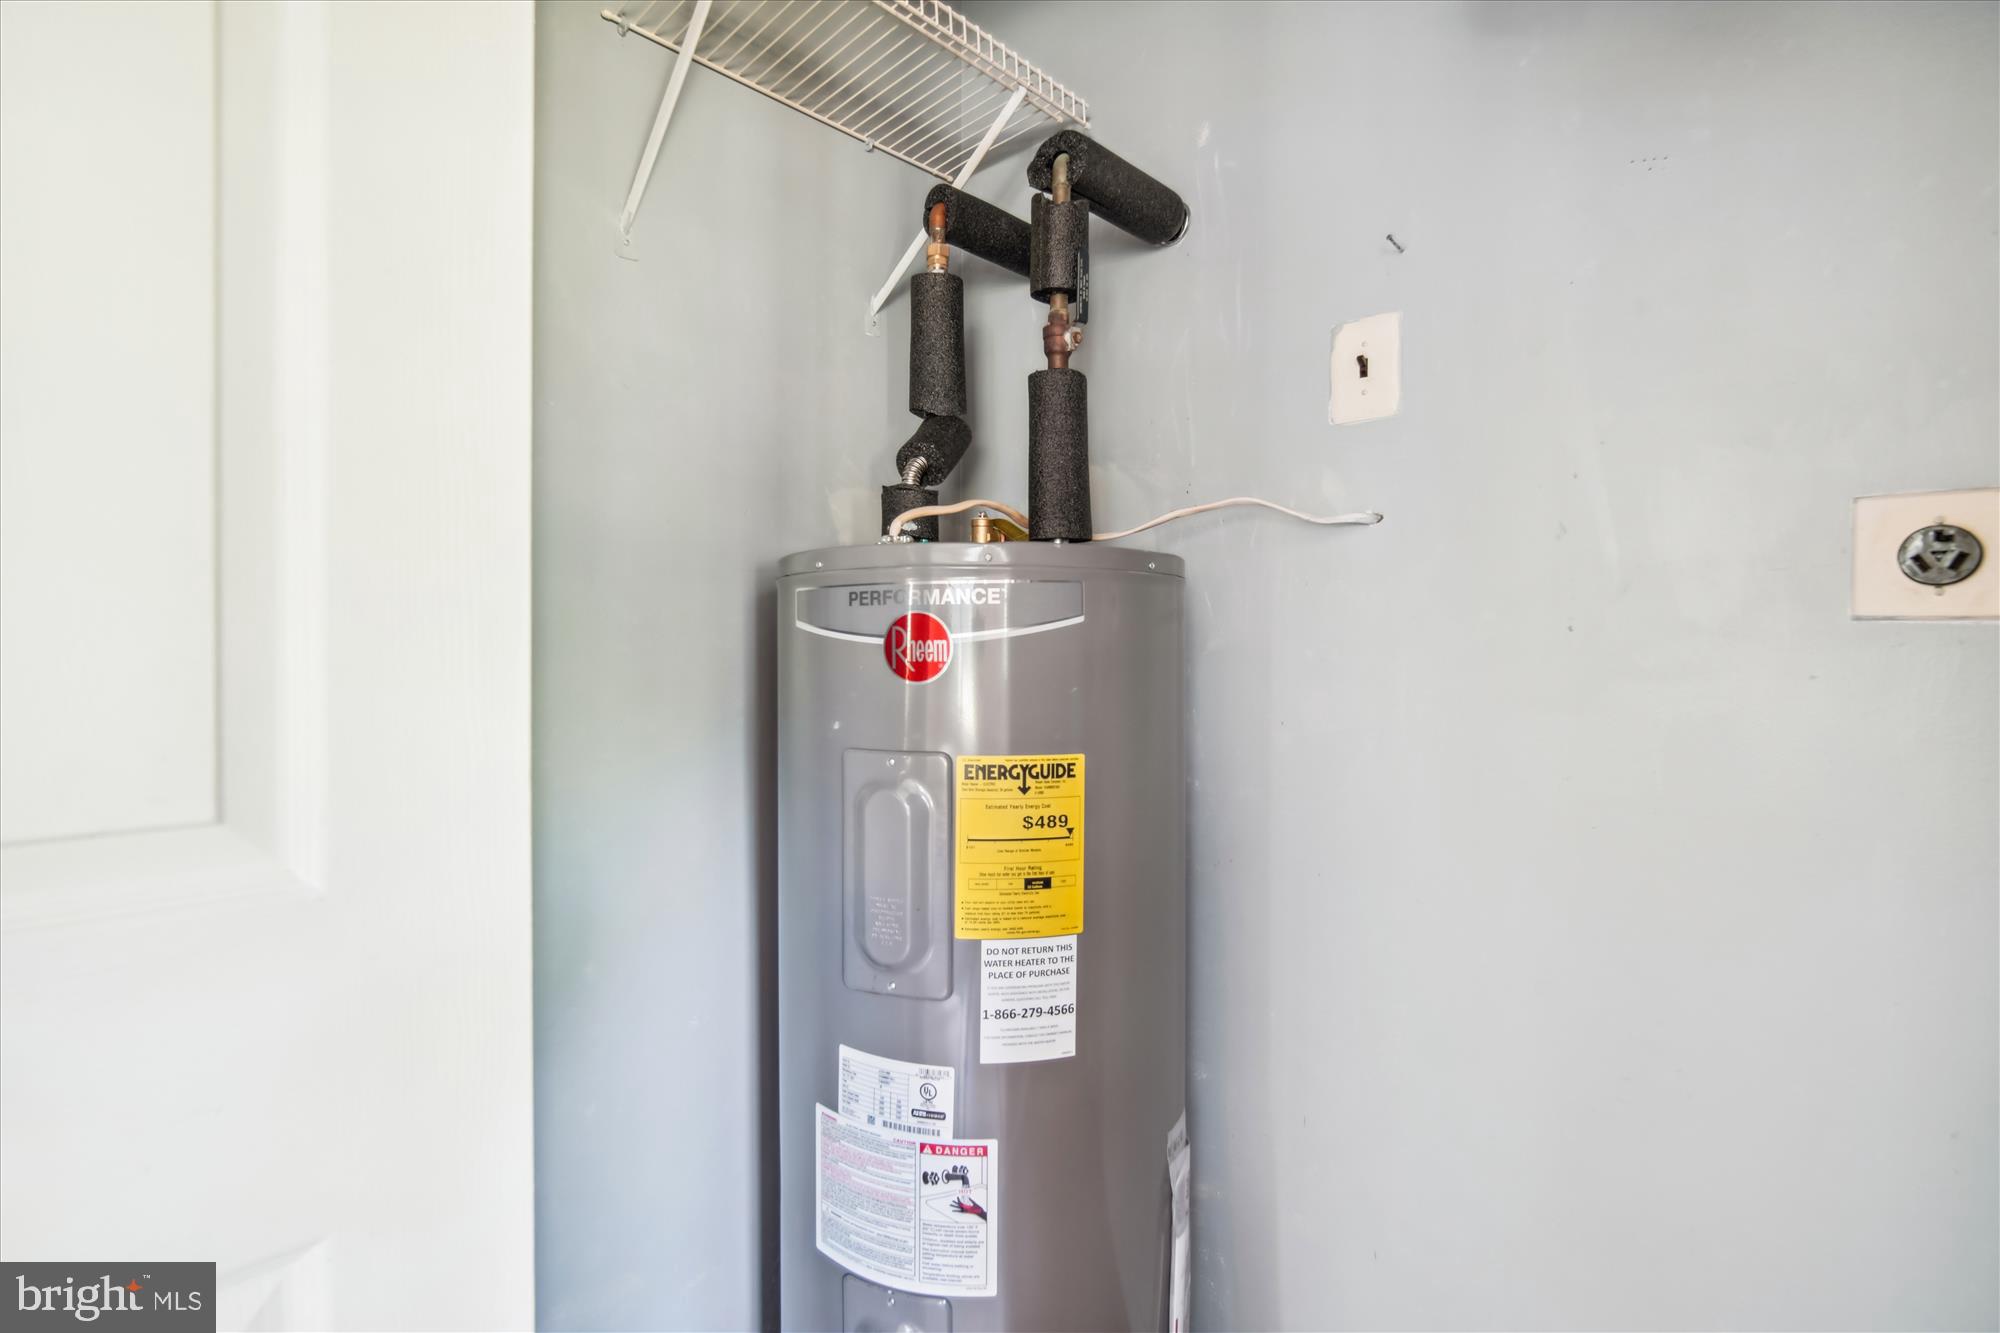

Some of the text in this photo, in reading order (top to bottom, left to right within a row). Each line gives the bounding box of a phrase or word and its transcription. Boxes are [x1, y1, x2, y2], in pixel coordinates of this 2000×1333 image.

[848, 587, 1002, 607] PERFORMANCE
[892, 625, 948, 672] Rheem
[964, 763, 1076, 781] ENERGYGUIDE
[1022, 814, 1069, 830] $489
[986, 943, 1073, 956] DO NOT RETURN THIS
[984, 955, 1075, 968] WATER HEATER TO THE
[988, 967, 1070, 979] PLACE OF PURCHASE
[983, 1003, 1075, 1020] 1-866-279-4566
[935, 1146, 984, 1156] DANGER
